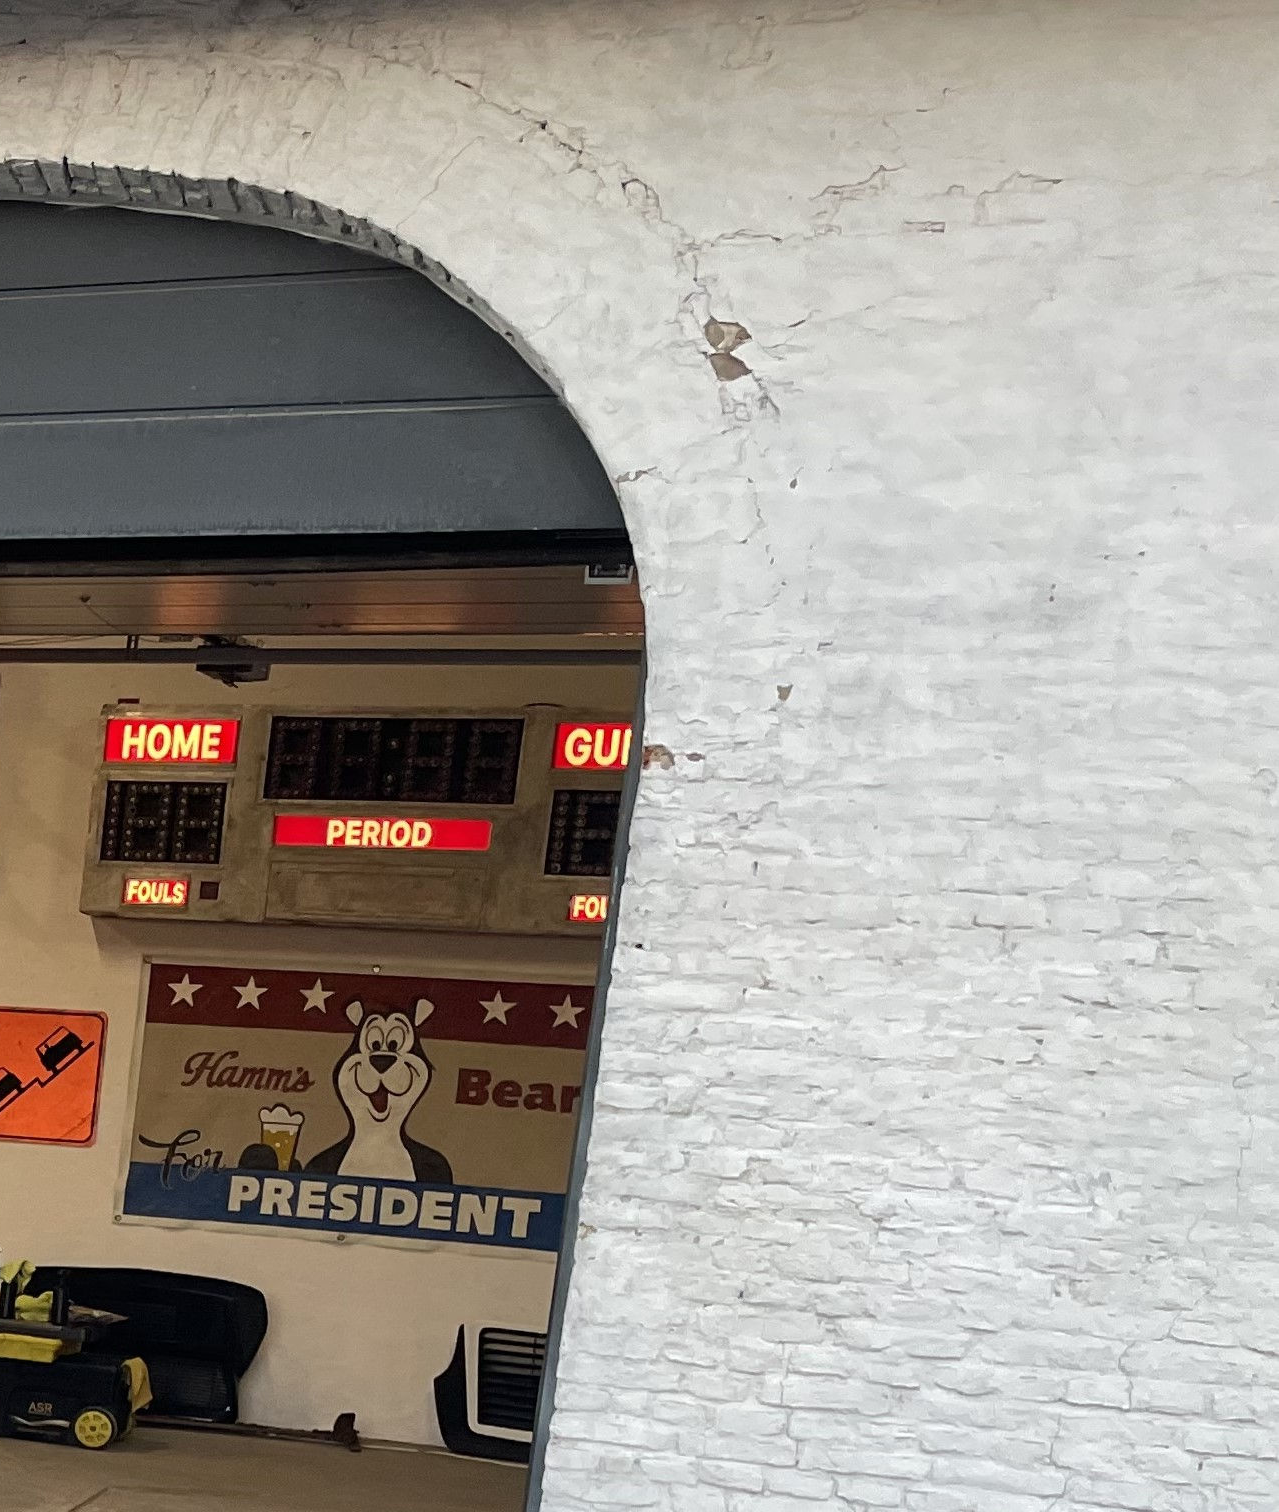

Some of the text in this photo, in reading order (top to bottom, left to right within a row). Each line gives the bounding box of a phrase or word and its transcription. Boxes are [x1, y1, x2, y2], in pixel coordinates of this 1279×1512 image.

[121, 724, 221, 760] HOME
[326, 819, 432, 848] PERIOD
[127, 880, 185, 904] FOULS
[181, 1051, 581, 1113] Hamm's Bear
[138, 1128, 226, 1190] For
[227, 1176, 541, 1239] PRESIDENT
